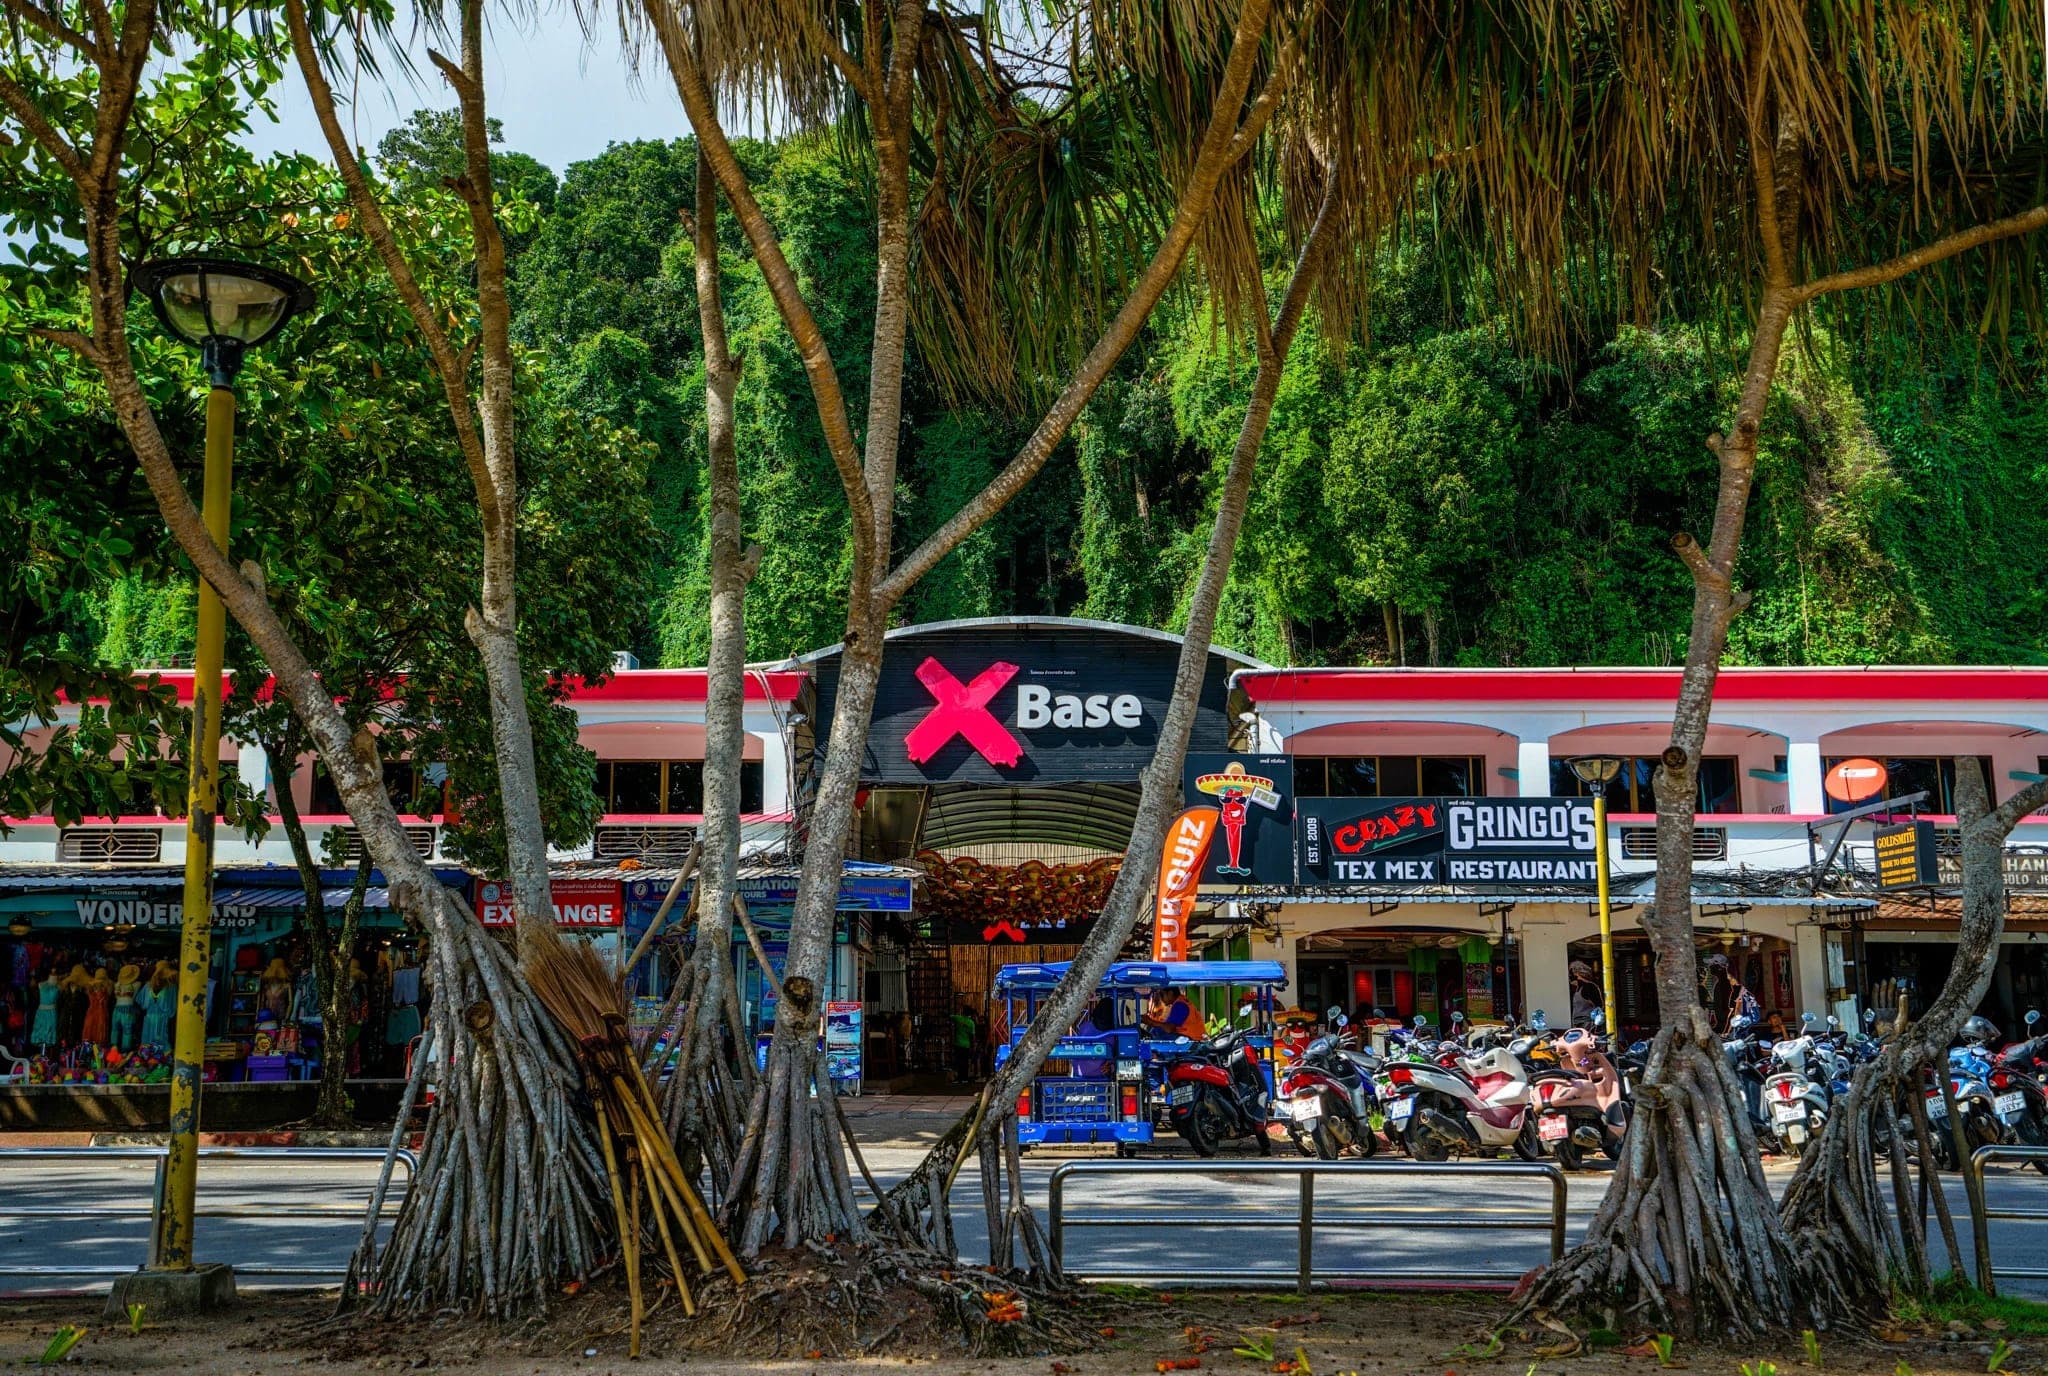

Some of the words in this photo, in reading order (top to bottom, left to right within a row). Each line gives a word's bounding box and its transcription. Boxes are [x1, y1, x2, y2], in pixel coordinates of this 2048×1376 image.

[1017, 684, 1142, 728] Base
[1334, 803, 1436, 853] CRAZY
[1449, 800, 1596, 850] GRINGO'S
[1876, 831, 1916, 849] GOLDSMITH
[1166, 817, 1205, 891] QUIZ
[1308, 843, 1318, 863] EST.
[1334, 861, 1376, 880] TEX
[1385, 861, 1434, 880] MEX
[1450, 861, 1598, 880] RESTAURANT
[218, 918, 256, 928] SHOP
